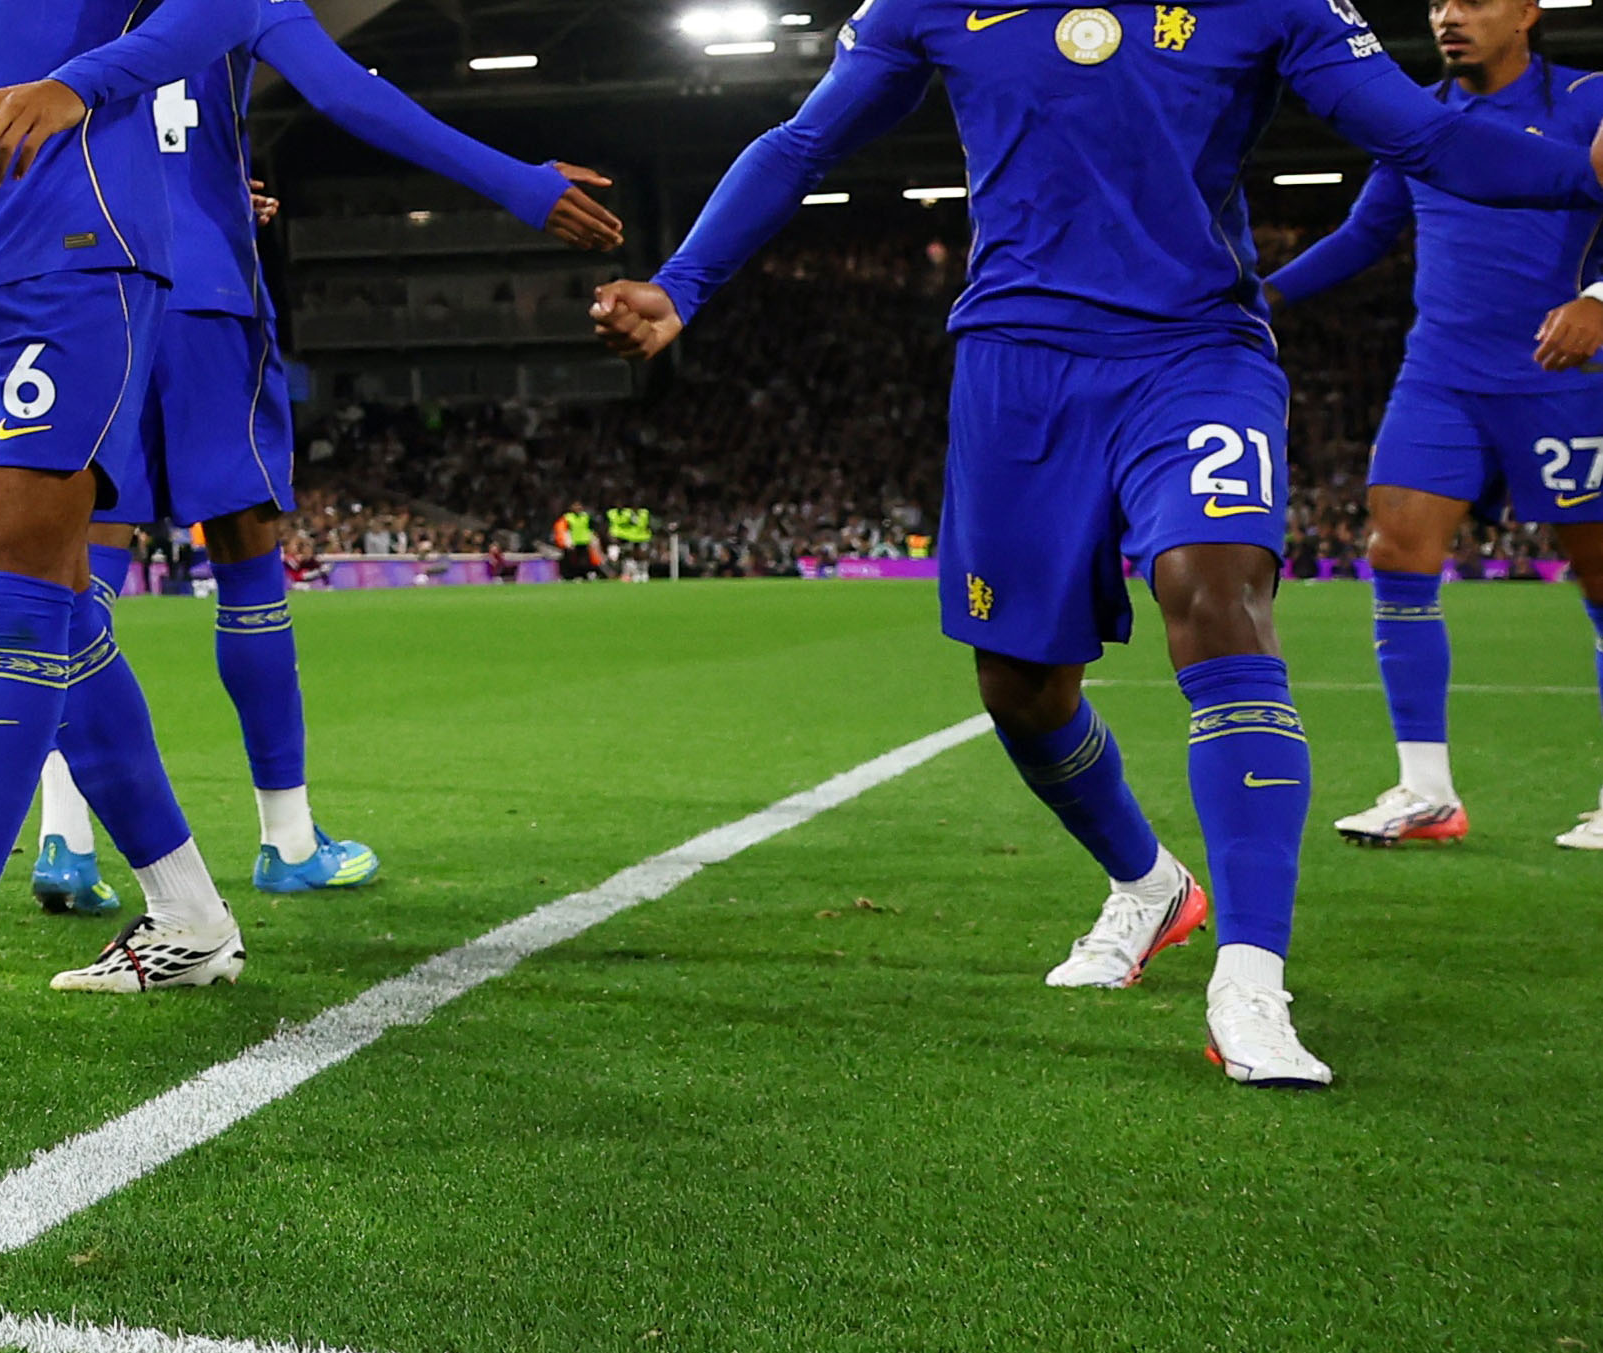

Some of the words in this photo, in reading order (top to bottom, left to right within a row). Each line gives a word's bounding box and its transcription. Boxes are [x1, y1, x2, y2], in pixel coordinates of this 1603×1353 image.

[3, 343, 56, 419] 6
[1187, 423, 1273, 508] 21
[1533, 436, 1603, 492] 27
